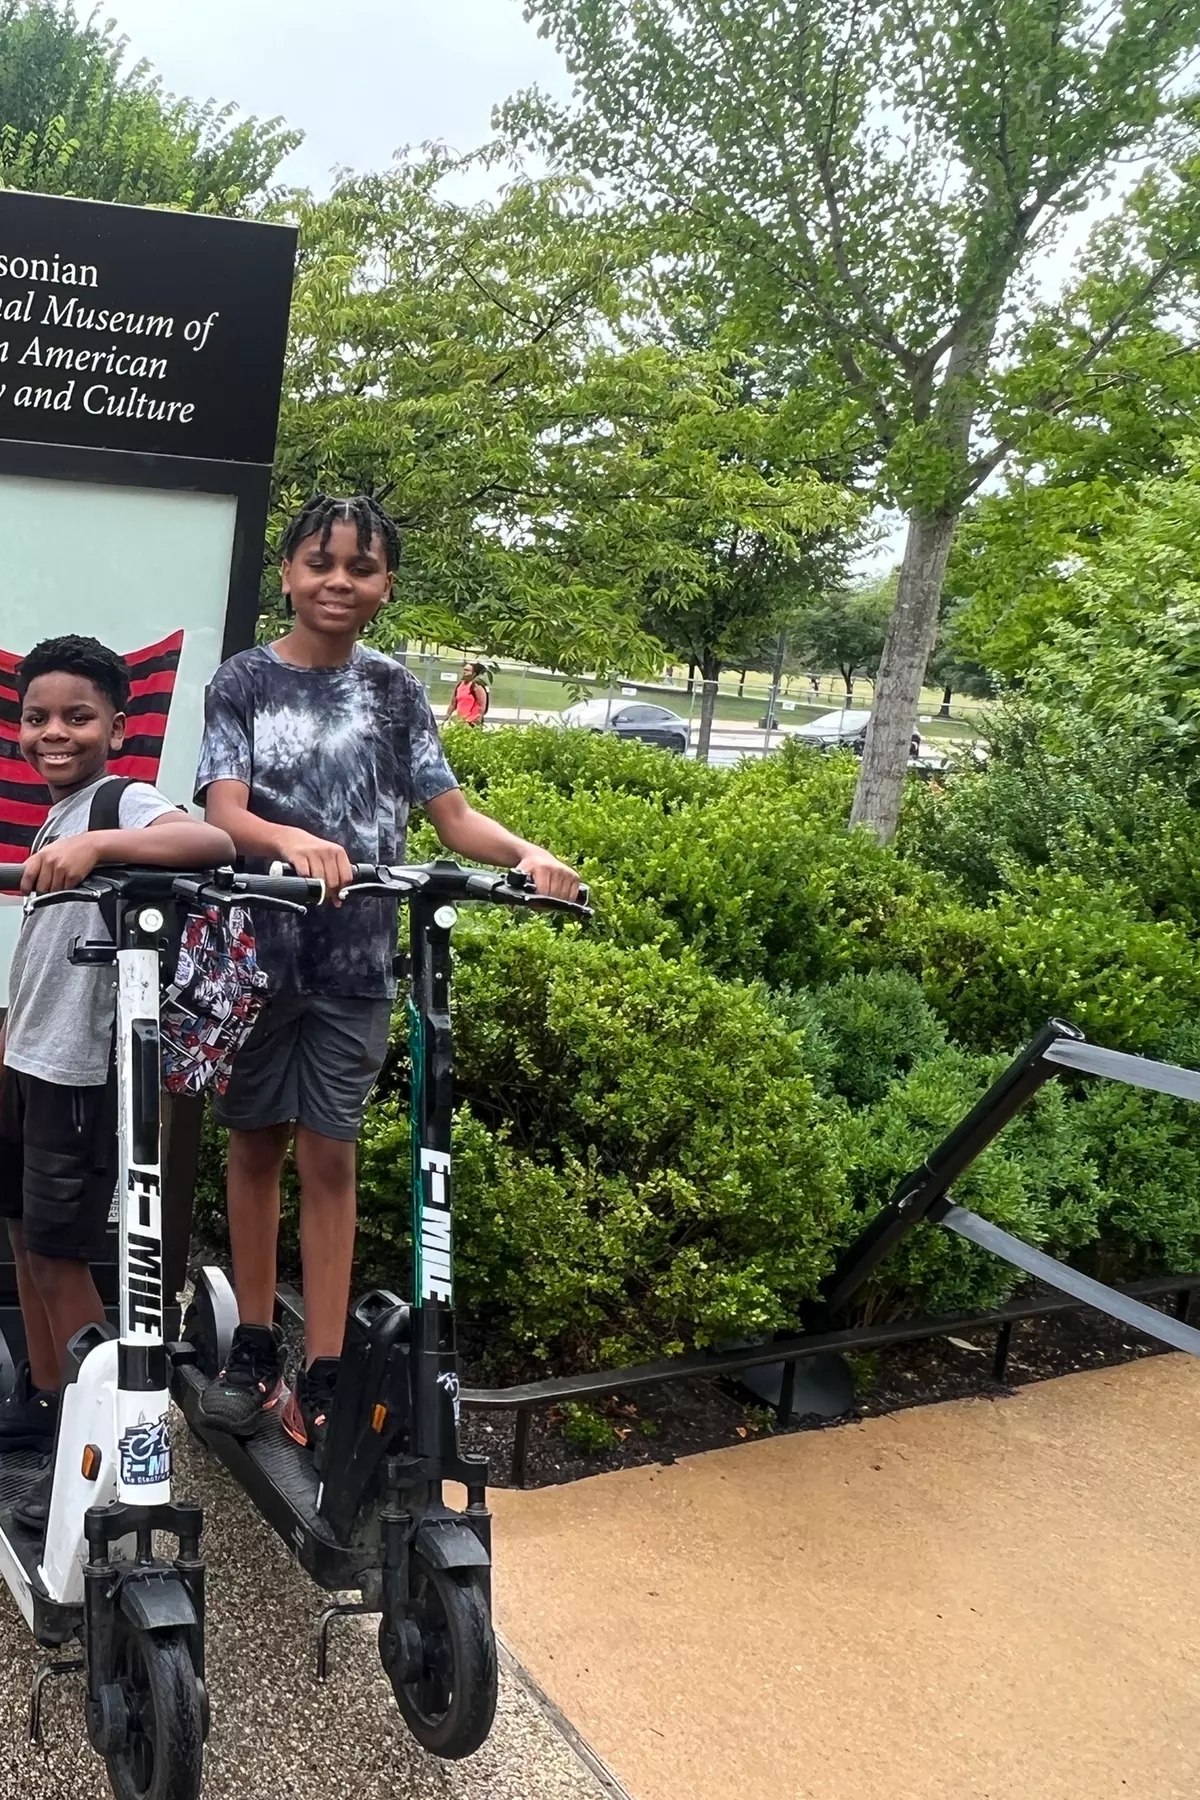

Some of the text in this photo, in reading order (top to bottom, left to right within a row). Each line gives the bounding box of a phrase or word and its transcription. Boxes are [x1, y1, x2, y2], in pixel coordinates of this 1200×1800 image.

[41, 295, 174, 339] Museum
[183, 311, 219, 352] of
[17, 336, 168, 379] American
[13, 381, 74, 412] and
[83, 384, 196, 424] Culture
[420, 1147, 452, 1305] E-MILE
[127, 1168, 162, 1338] E-MILE
[122, 1451, 170, 1479] E-MI
